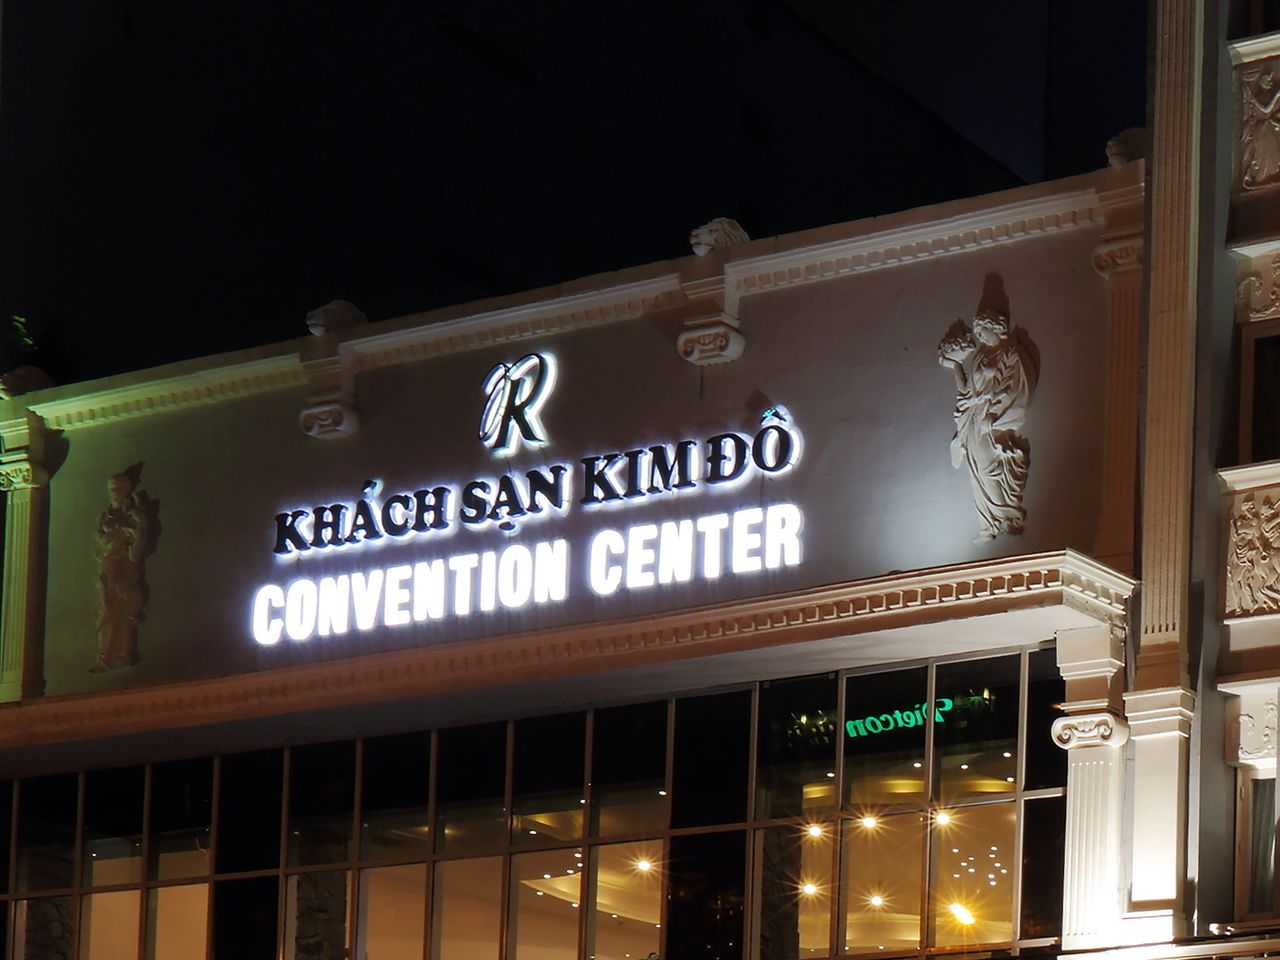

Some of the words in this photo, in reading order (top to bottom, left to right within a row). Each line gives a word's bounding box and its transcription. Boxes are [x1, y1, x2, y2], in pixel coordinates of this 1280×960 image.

[272, 479, 452, 555] KHÁCH
[459, 464, 570, 532] SẠN
[580, 439, 698, 504] KIM
[706, 406, 797, 485] ĐÔ
[252, 538, 568, 645] CONVENTION
[589, 503, 803, 595] CENTER
